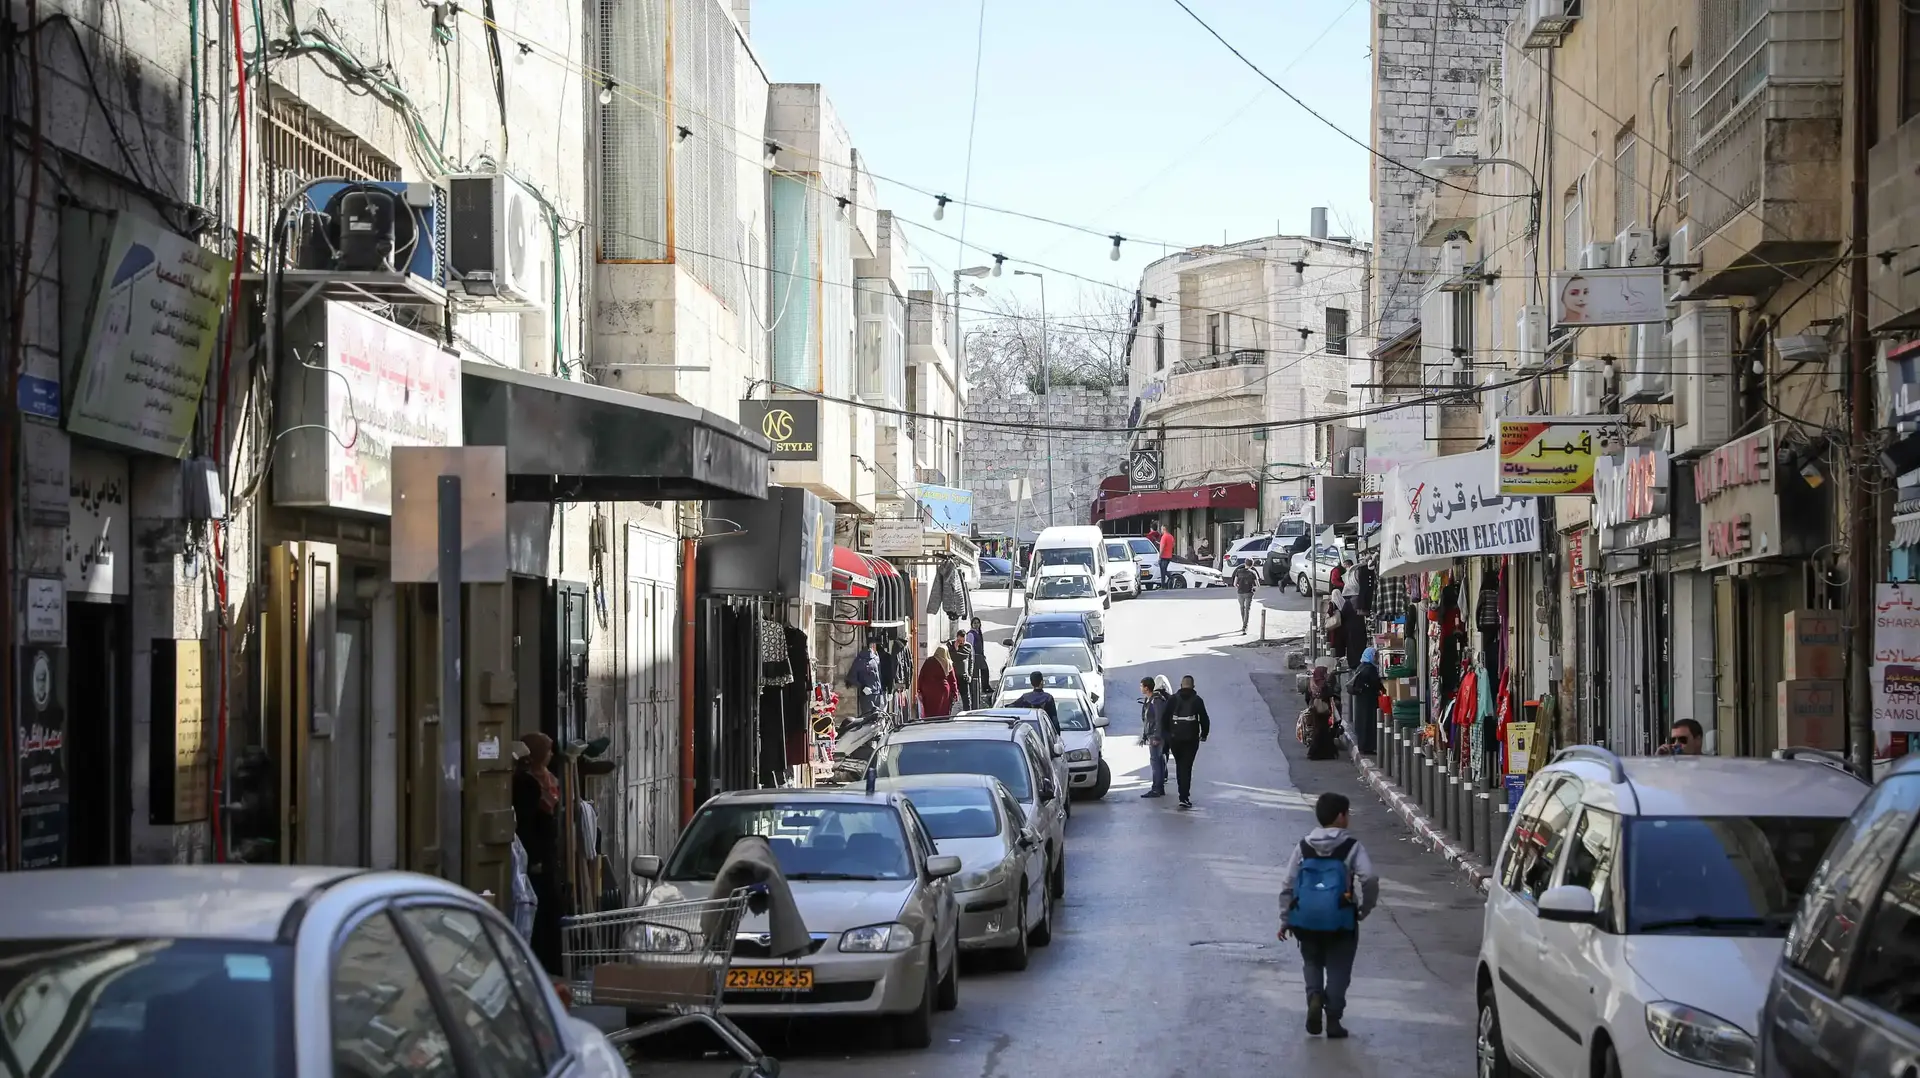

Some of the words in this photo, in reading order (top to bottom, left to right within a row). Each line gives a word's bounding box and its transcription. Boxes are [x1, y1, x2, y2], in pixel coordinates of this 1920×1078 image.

[776, 442, 813, 452] STYLE
[1531, 429, 1592, 458] قمر
[1427, 482, 1466, 523] قرش
[1471, 484, 1534, 514] رباء
